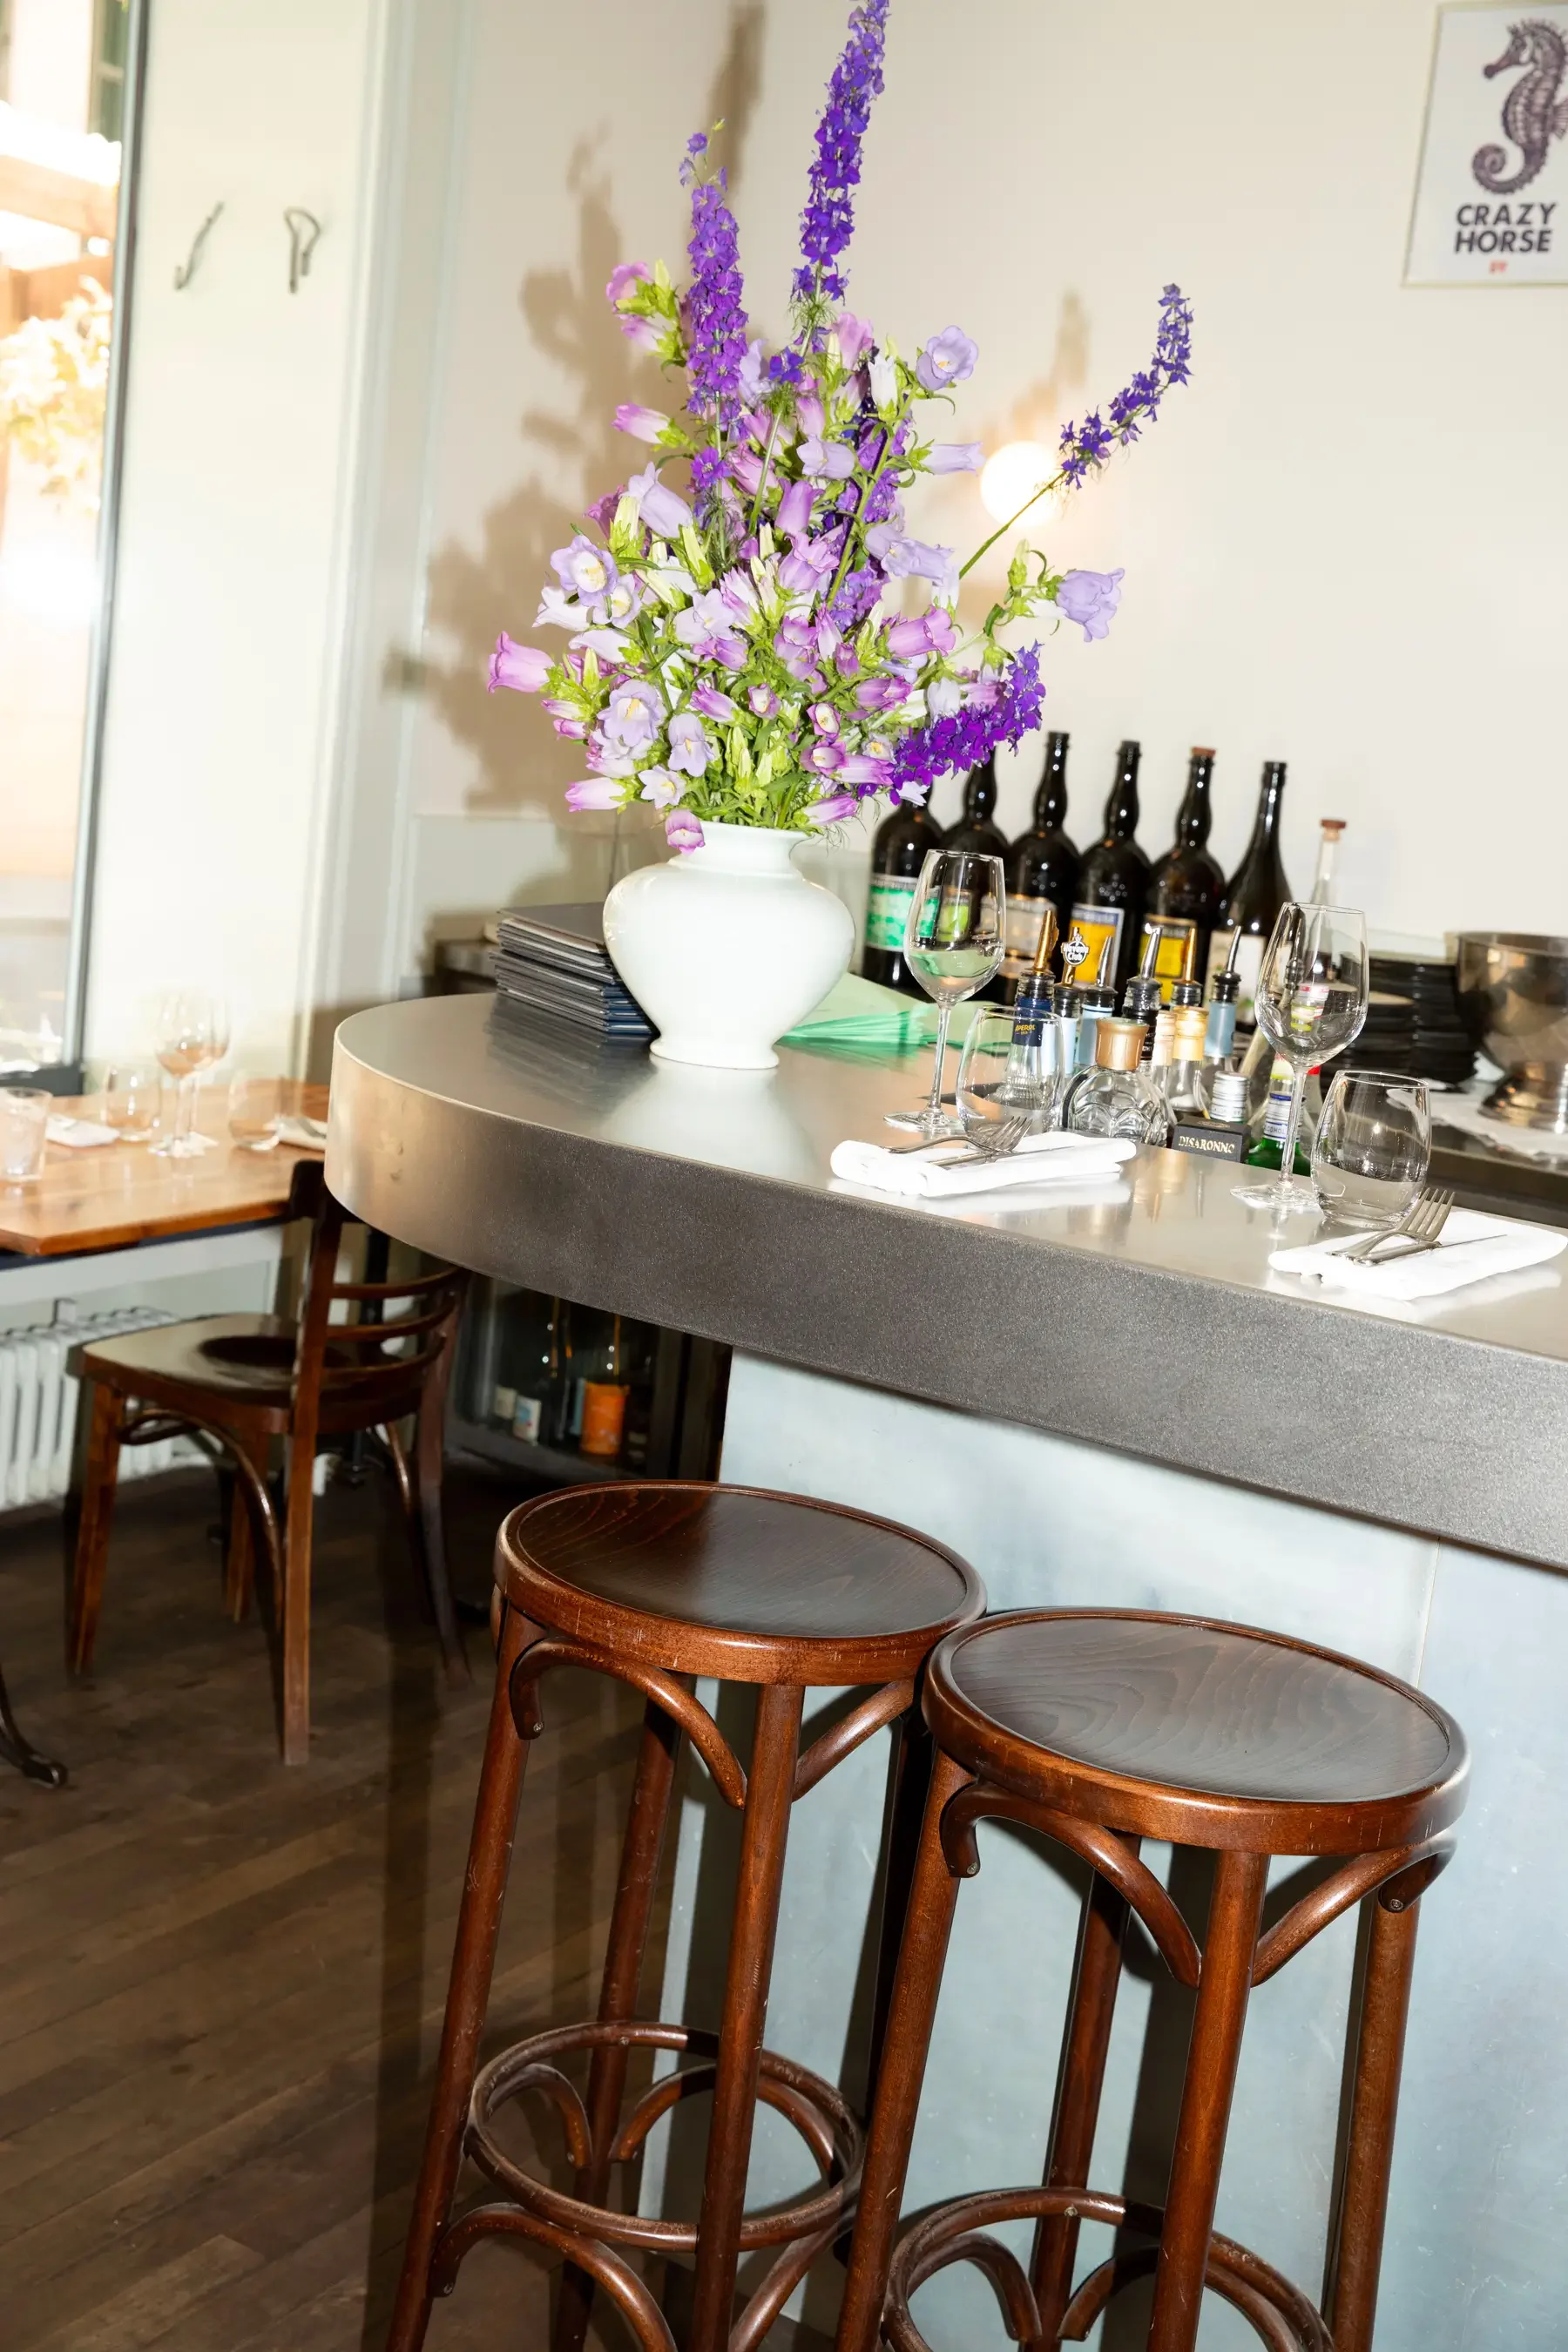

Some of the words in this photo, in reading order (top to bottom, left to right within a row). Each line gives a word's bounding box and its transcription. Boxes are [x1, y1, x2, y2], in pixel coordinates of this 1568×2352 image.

[1456, 202, 1557, 226] CRAZY
[1455, 228, 1552, 253] HORSE
[1067, 951, 1083, 961] Club
[1015, 1024, 1036, 1032] APEROL
[1179, 1136, 1235, 1154] DISARONNO
